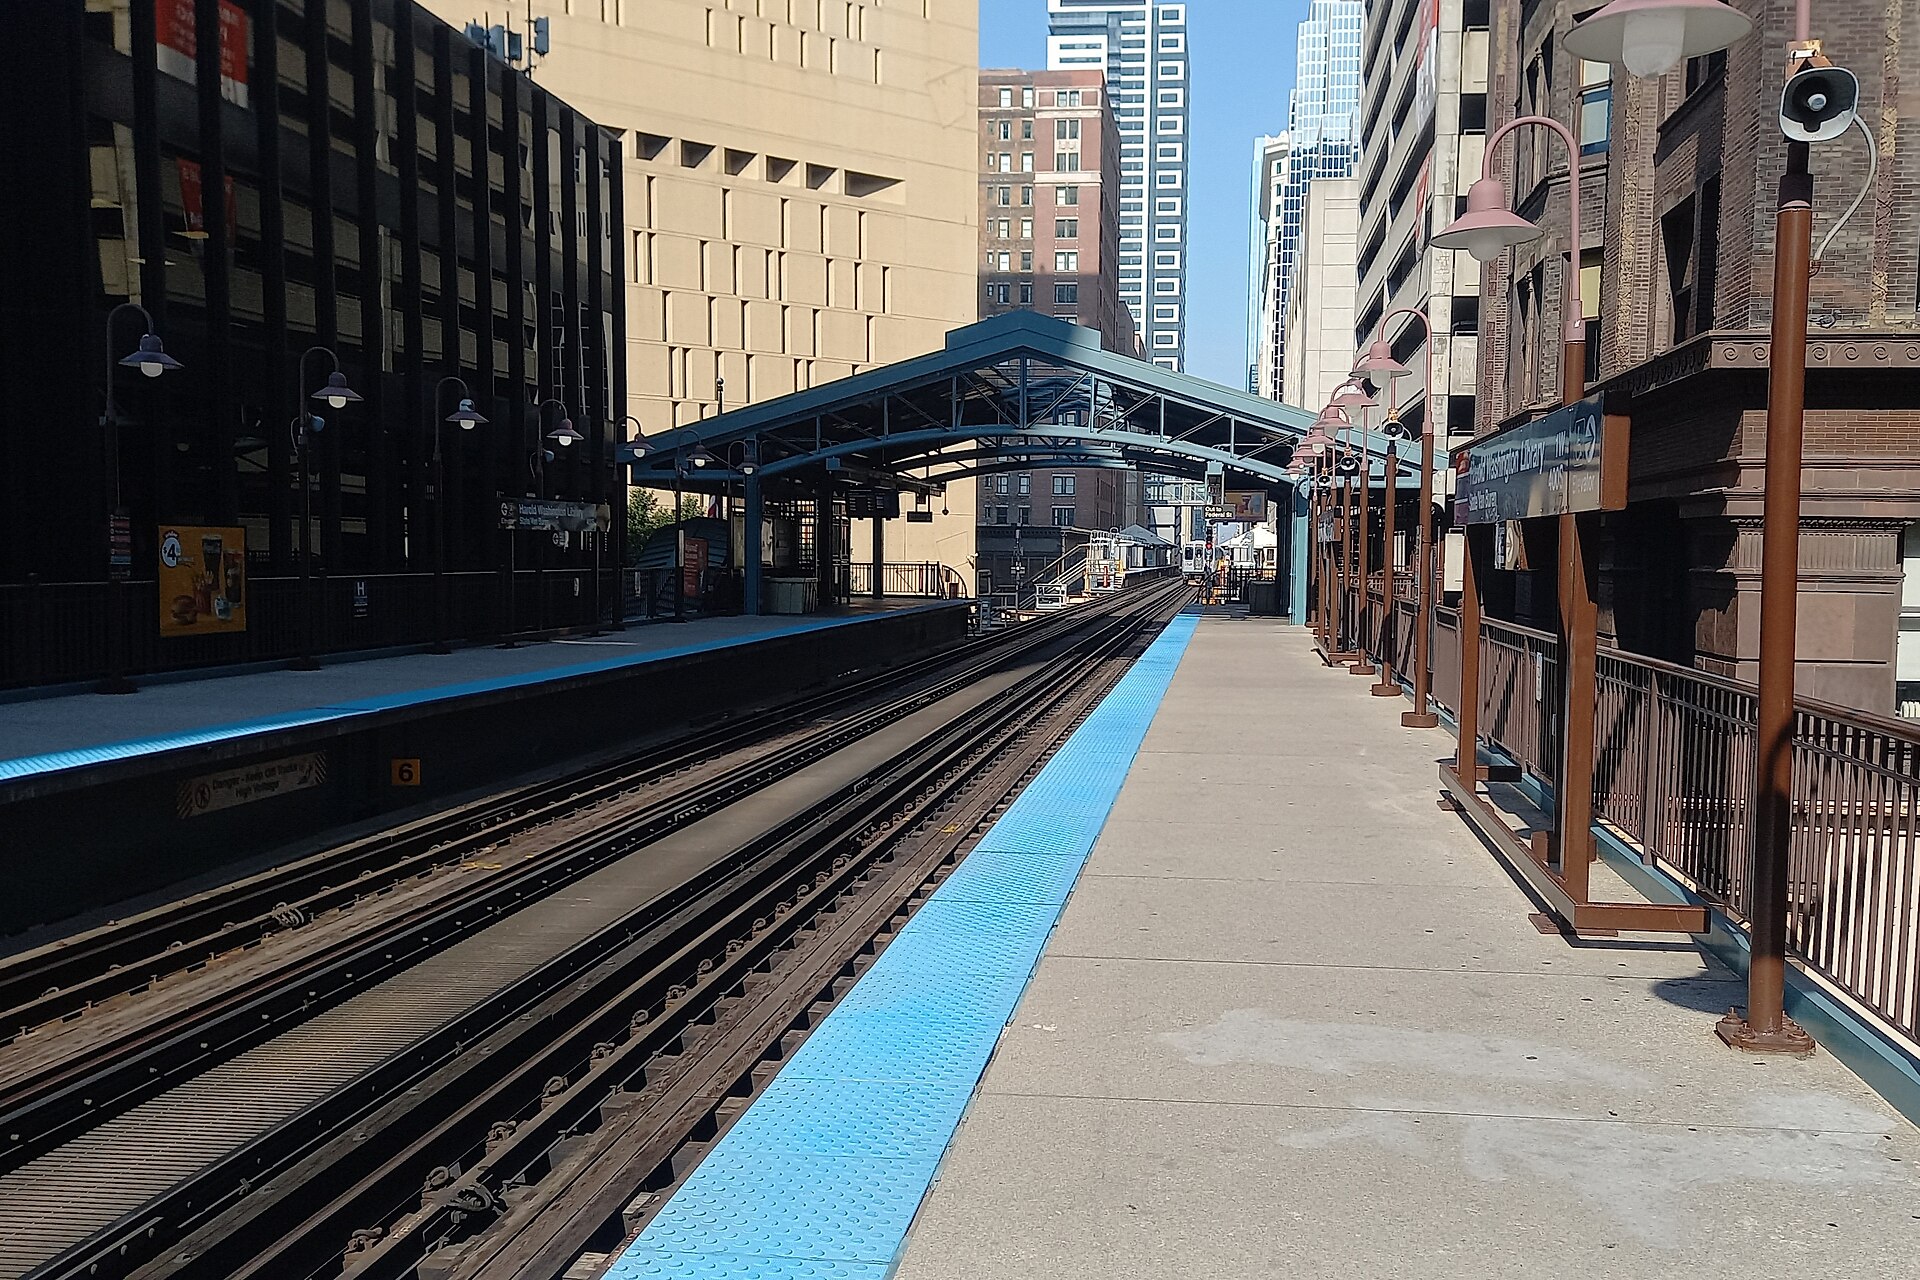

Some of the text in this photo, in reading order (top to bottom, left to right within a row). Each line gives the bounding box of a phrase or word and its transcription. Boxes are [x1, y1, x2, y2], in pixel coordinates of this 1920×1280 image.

[1486, 448, 1519, 483] Washington
[1520, 439, 1546, 474] Library
[357, 581, 365, 596] H
[212, 777, 240, 790] Danger
[245, 771, 263, 783] Keep
[264, 767, 276, 778] Off
[398, 763, 413, 782] 6
[235, 786, 251, 798] High
